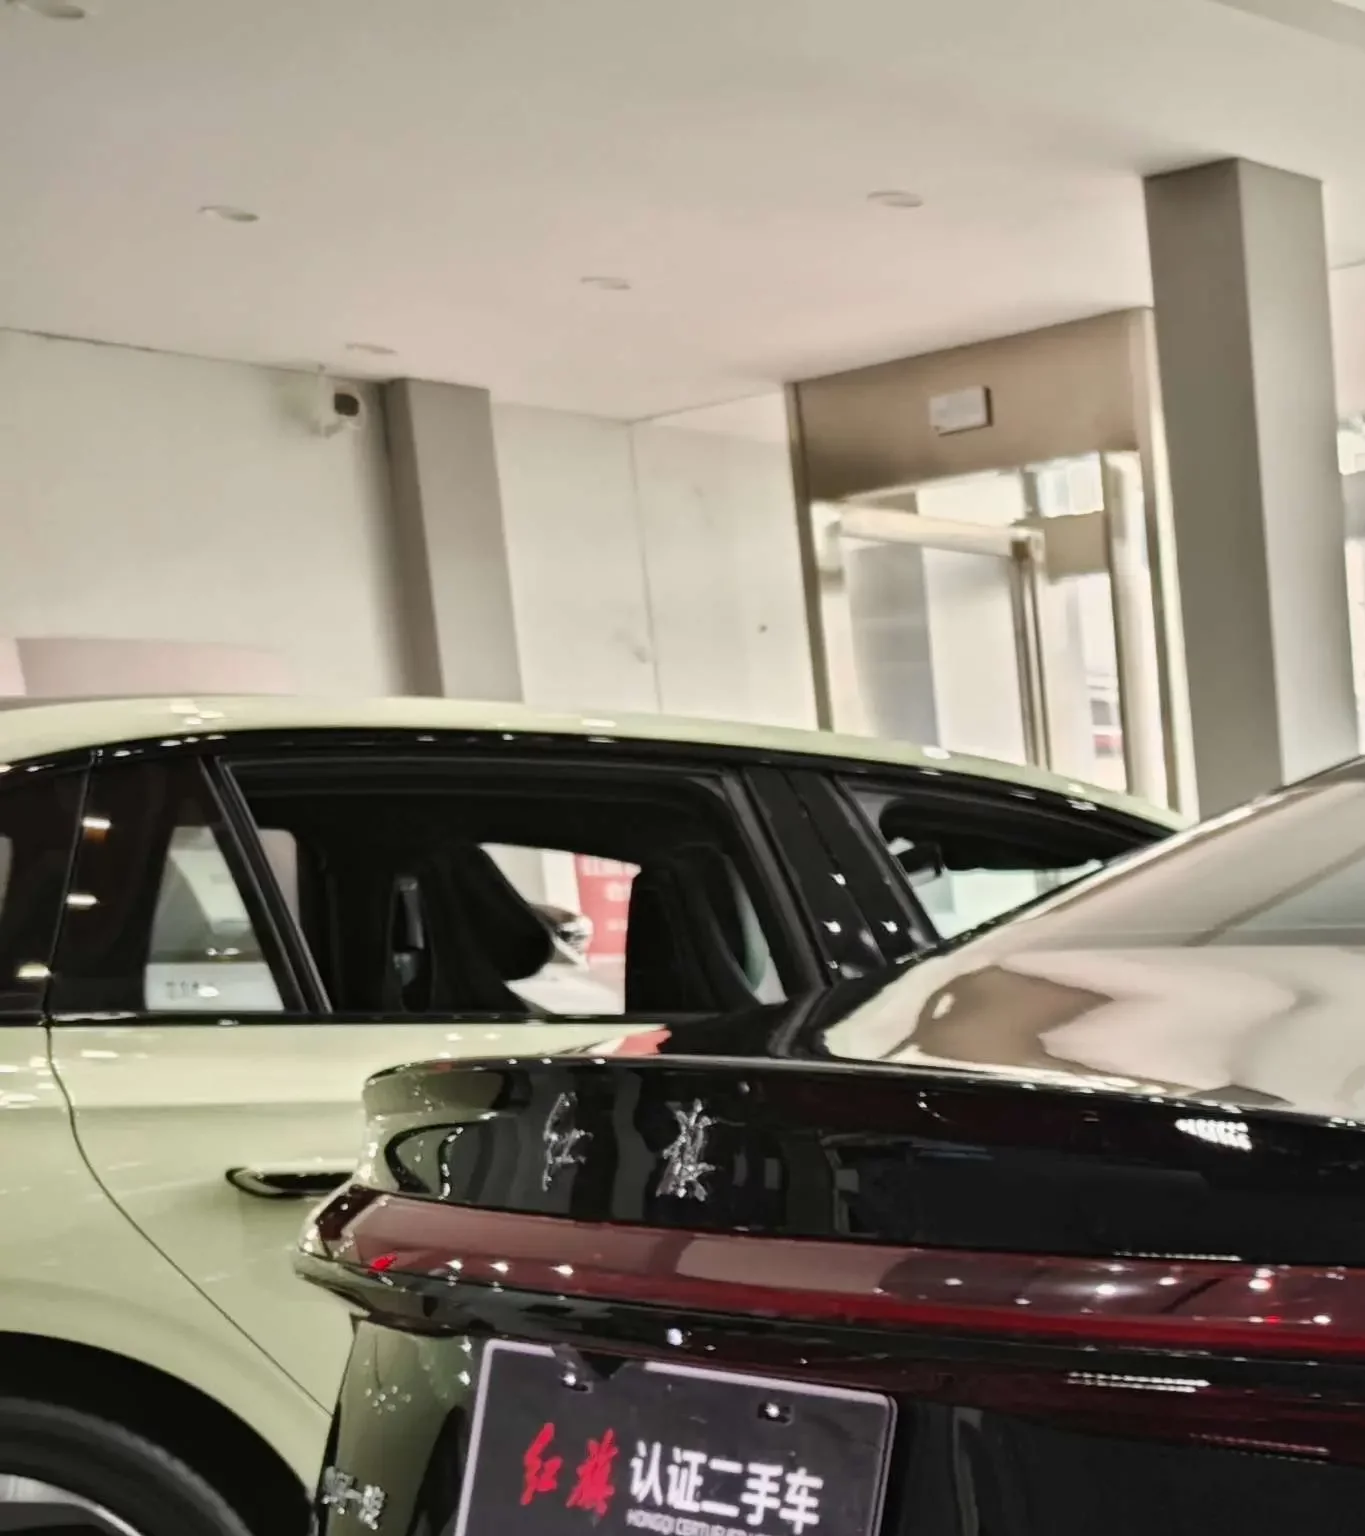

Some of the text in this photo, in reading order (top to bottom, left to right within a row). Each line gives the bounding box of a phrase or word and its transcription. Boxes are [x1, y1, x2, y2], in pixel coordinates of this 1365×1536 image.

[629, 1440, 824, 1535] 认证二手车
